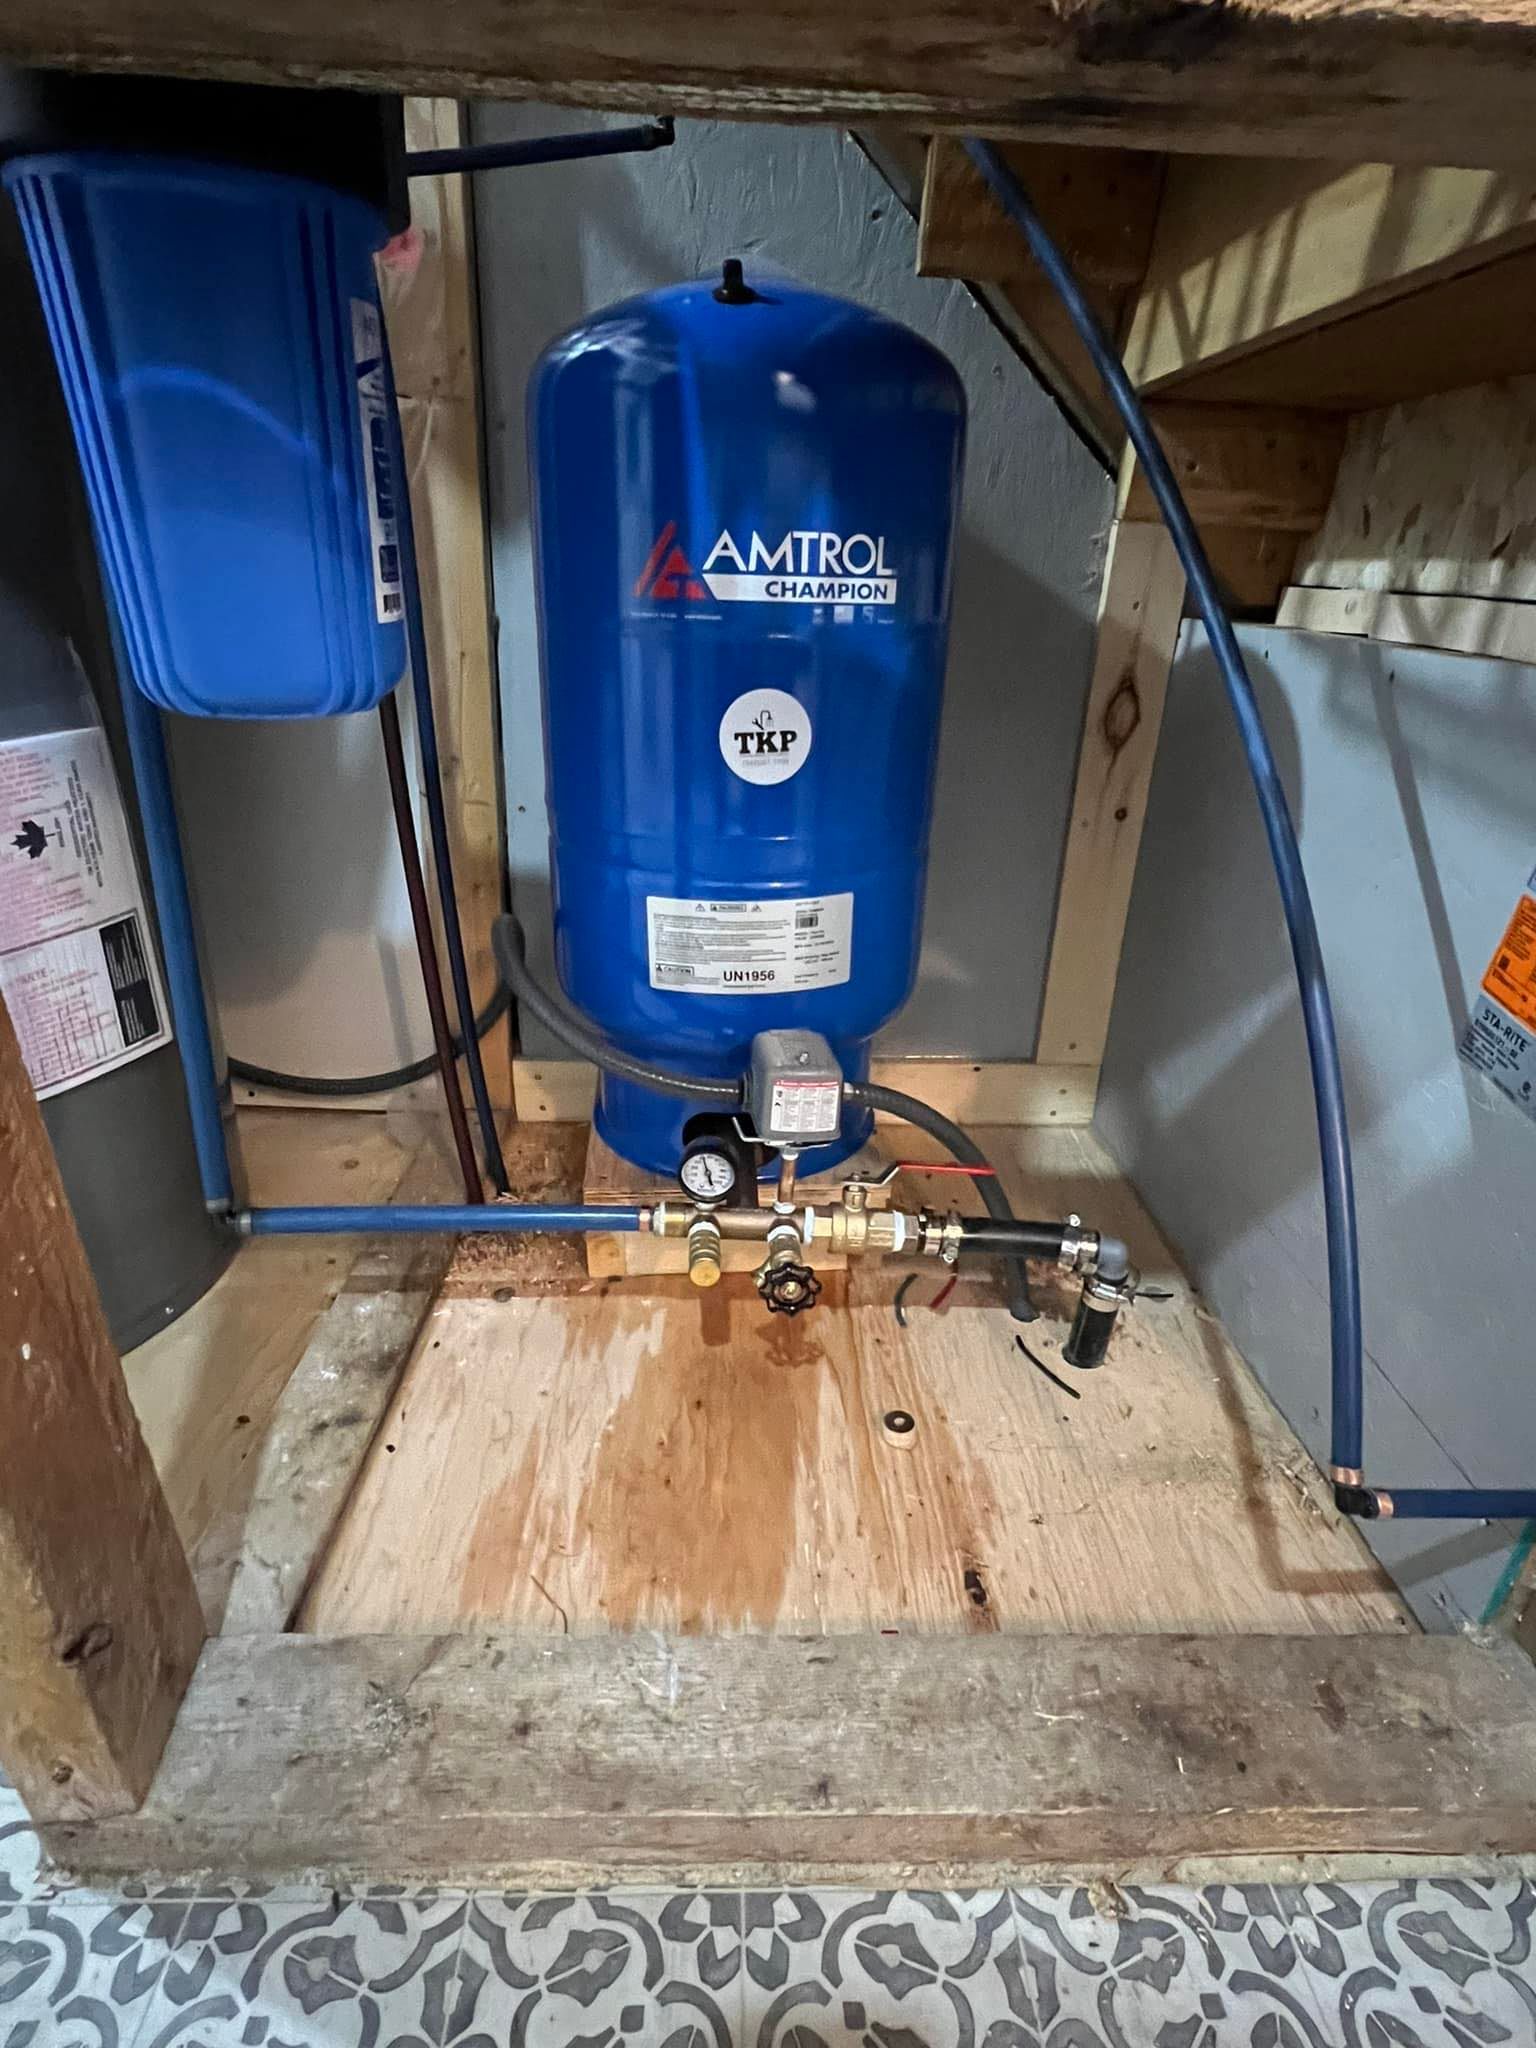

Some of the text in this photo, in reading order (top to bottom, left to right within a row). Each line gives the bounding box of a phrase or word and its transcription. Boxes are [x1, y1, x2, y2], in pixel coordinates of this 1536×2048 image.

[702, 529, 893, 575] AMTROL
[765, 580, 888, 601] CHAMPION
[734, 730, 798, 755] TKP
[723, 969, 775, 982] UN1956
[1482, 1008, 1528, 1053] STA-RITE
